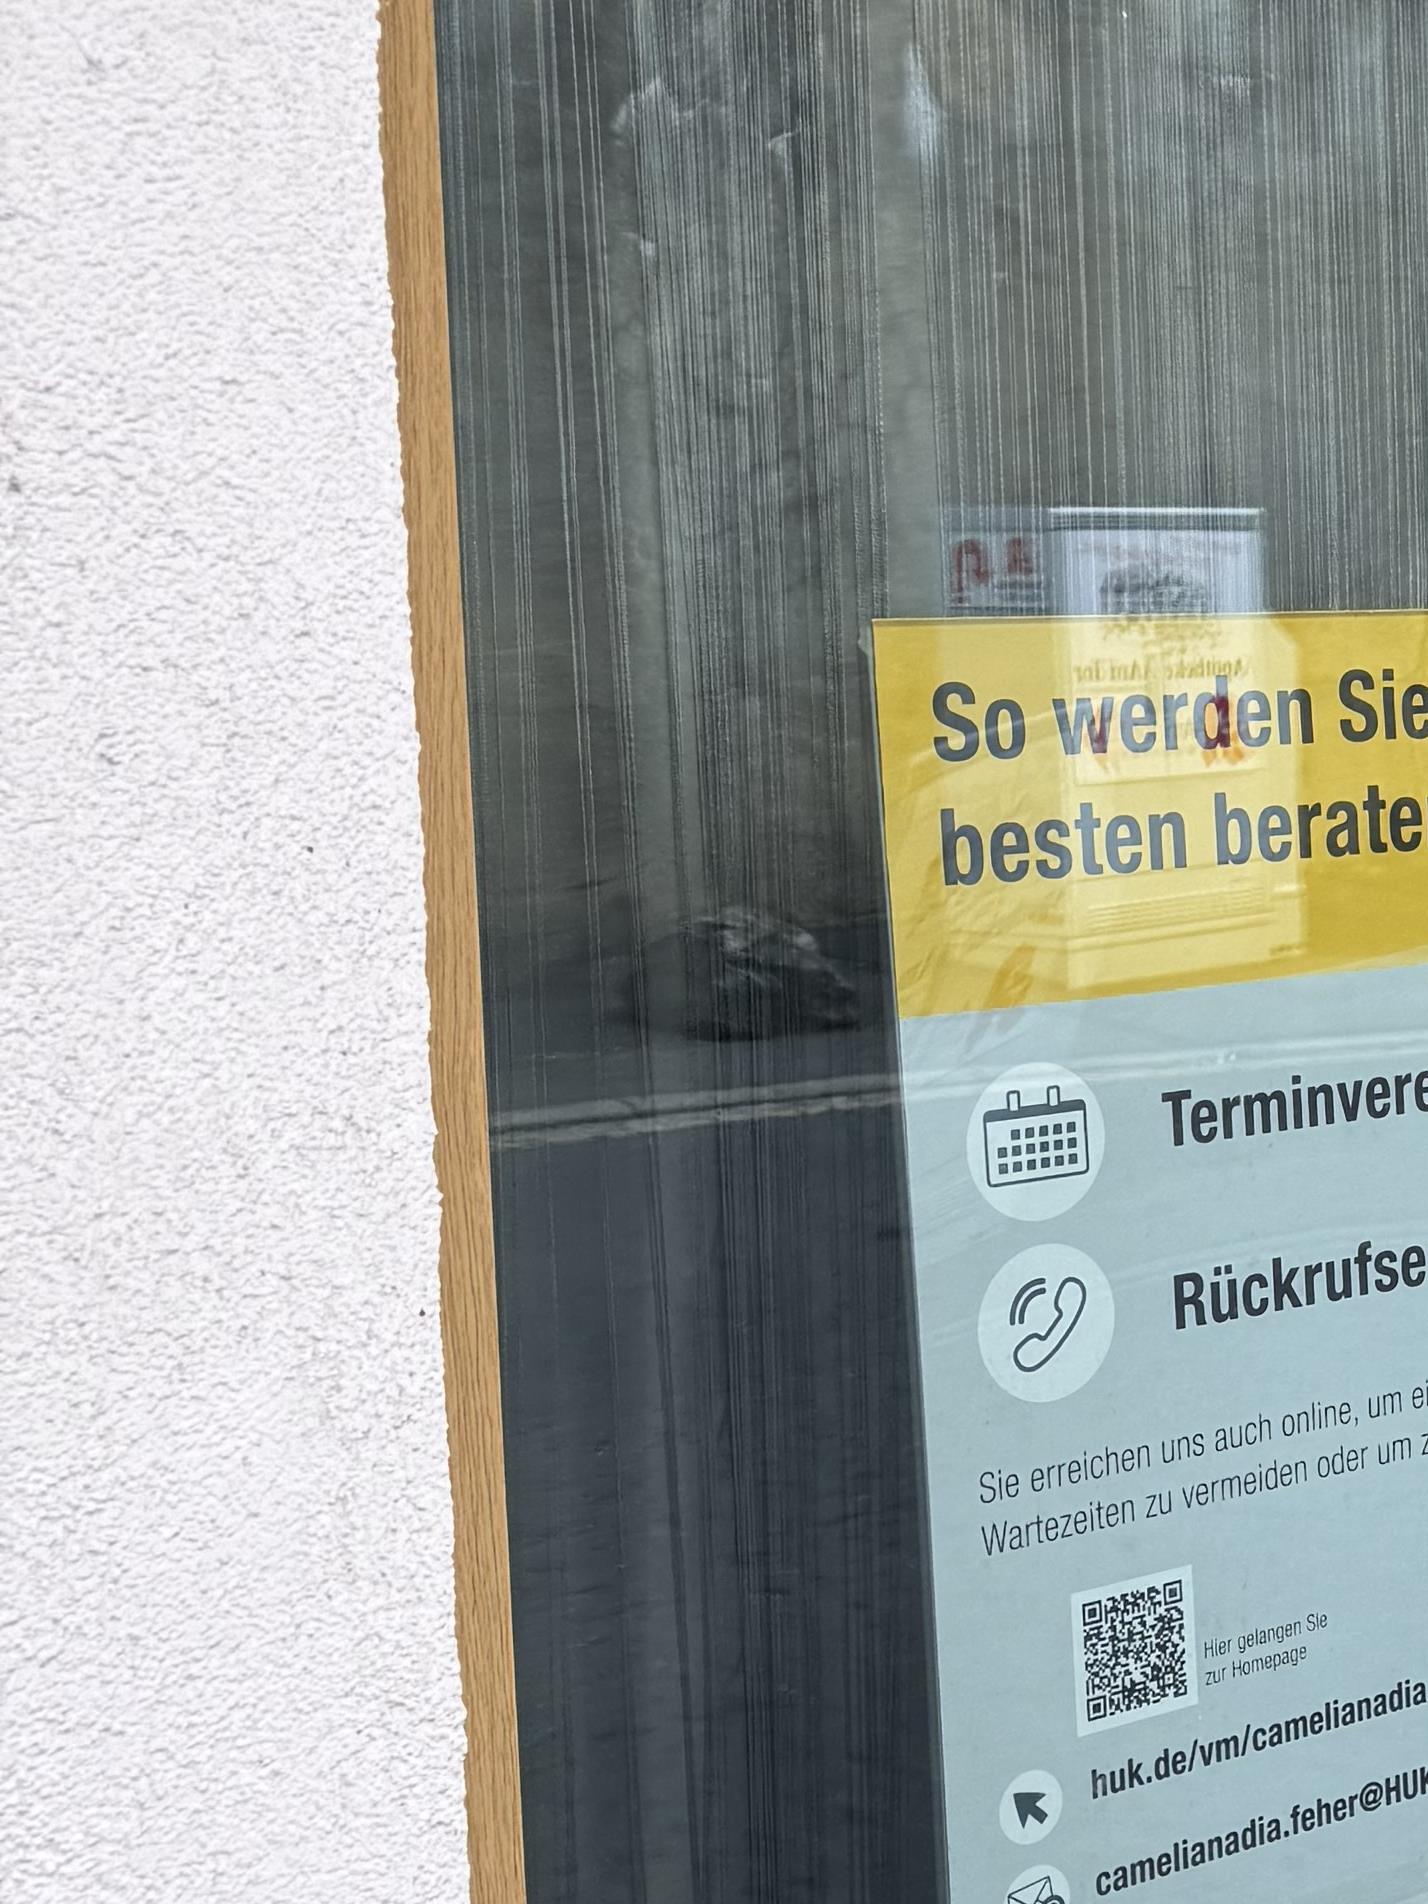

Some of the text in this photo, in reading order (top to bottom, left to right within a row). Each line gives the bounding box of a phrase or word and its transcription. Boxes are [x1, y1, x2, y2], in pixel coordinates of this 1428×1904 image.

[932, 680, 1026, 763] So
[1051, 674, 1315, 756] werden
[939, 801, 1189, 887] besten
[979, 1468, 1020, 1504] Sie
[1030, 1444, 1152, 1492] erreichen
[1161, 1432, 1205, 1464] uns
[1214, 1413, 1272, 1452] auch
[1281, 1401, 1360, 1437] online,
[1367, 1391, 1403, 1420] um
[980, 1497, 1136, 1557] Wartezeiten
[1145, 1489, 1173, 1520] zu
[1181, 1459, 1308, 1510] vermeiden
[1316, 1445, 1369, 1480] oder
[1377, 1436, 1412, 1466] um
[1204, 1612, 1328, 1659] Hier gelangen Sie
[1205, 1646, 1307, 1686] zur Homepage
